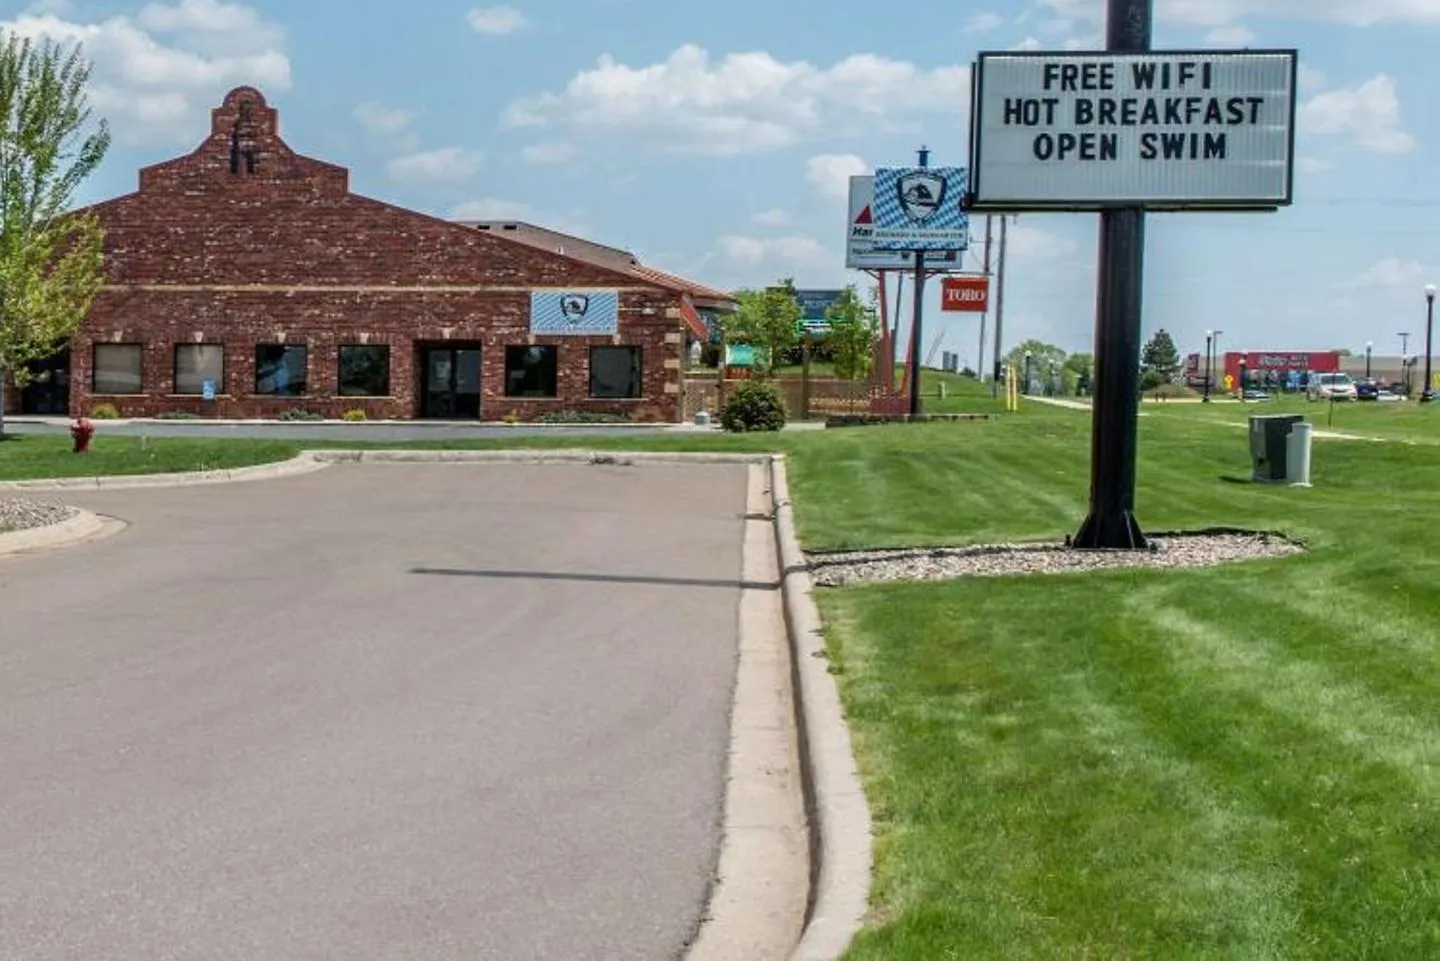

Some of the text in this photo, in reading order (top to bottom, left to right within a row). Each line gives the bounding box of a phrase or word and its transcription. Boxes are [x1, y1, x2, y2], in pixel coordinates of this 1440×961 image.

[1043, 62, 1211, 91] FREE WIFI
[1004, 97, 1264, 126] HOT BREAKFAST
[1033, 133, 1227, 161] OPEN SWIM
